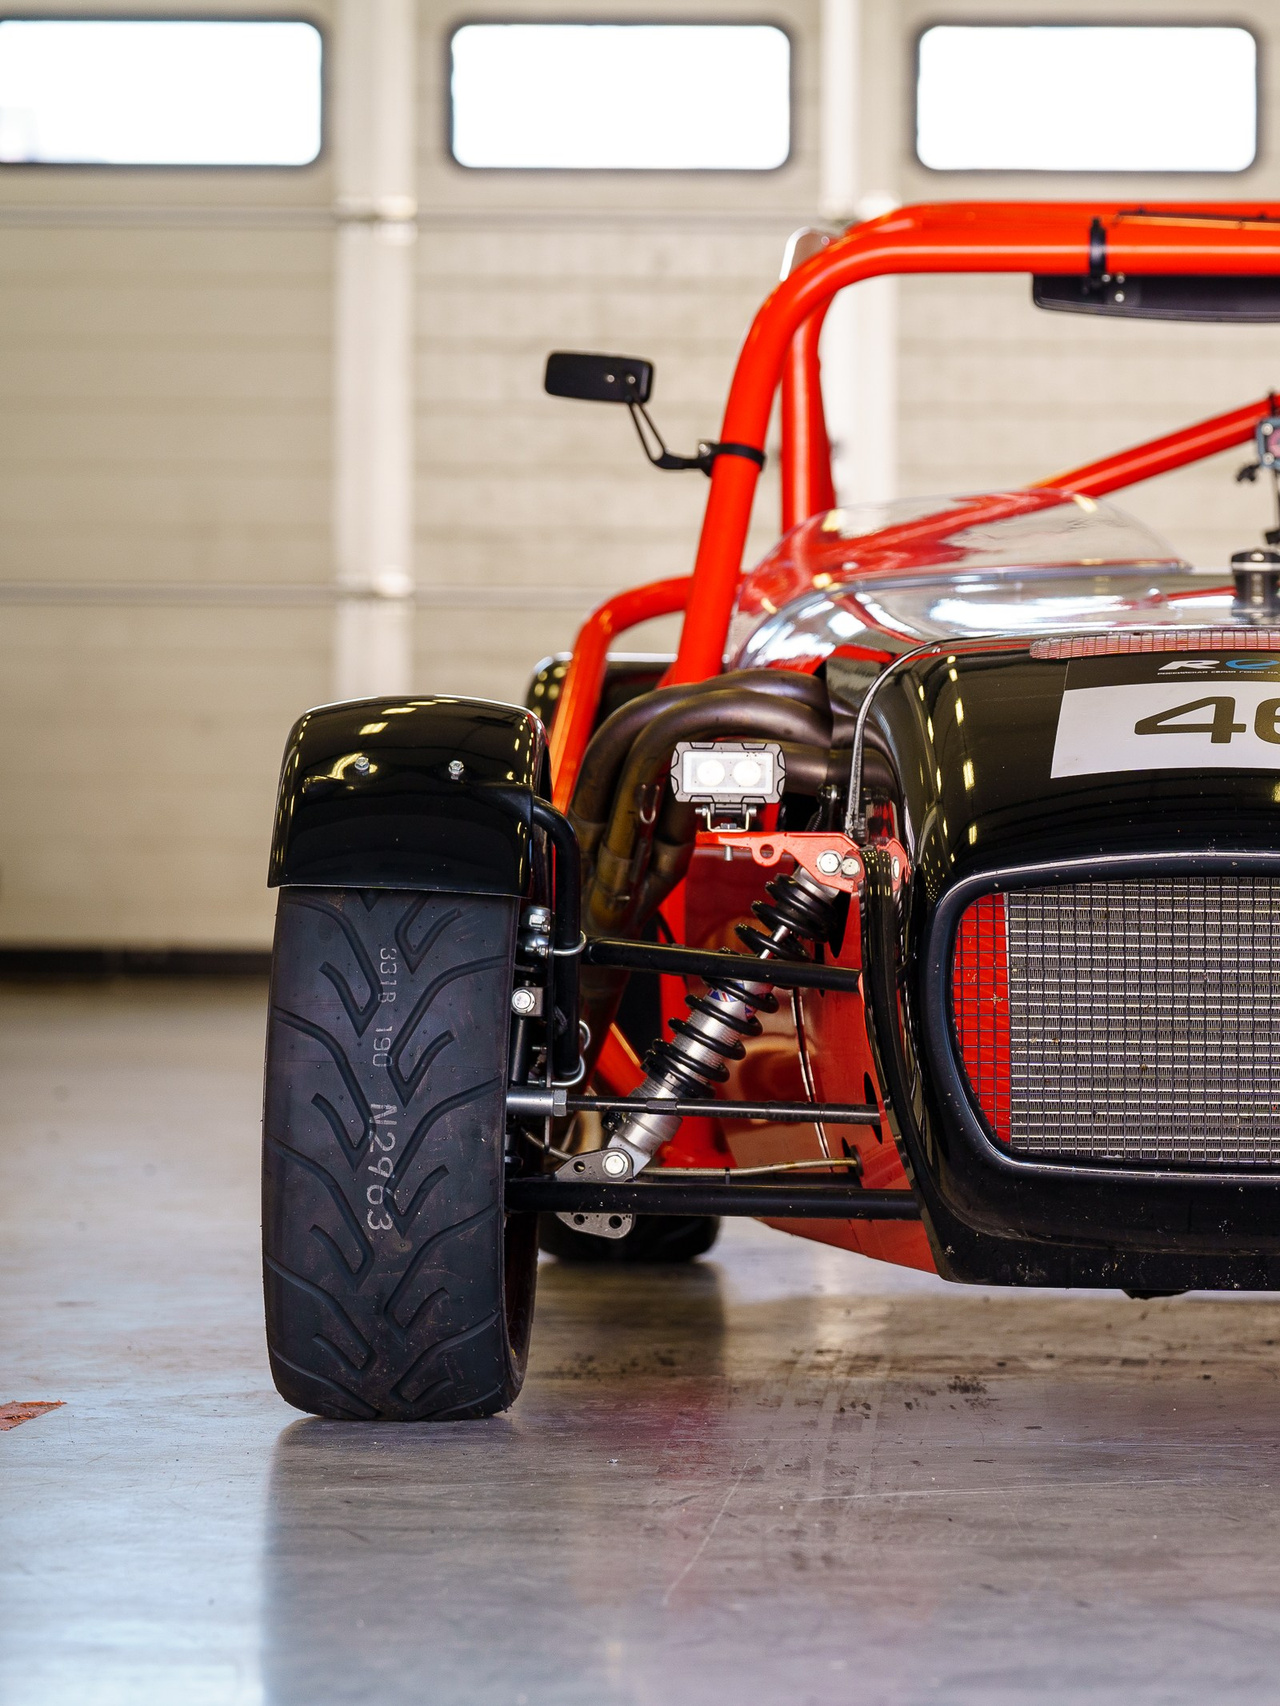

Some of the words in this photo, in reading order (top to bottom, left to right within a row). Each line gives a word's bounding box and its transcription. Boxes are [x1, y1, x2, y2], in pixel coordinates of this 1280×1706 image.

[377, 947, 397, 1004] 331B
[372, 1025, 394, 1068] 190
[366, 1103, 398, 1231] N2963
